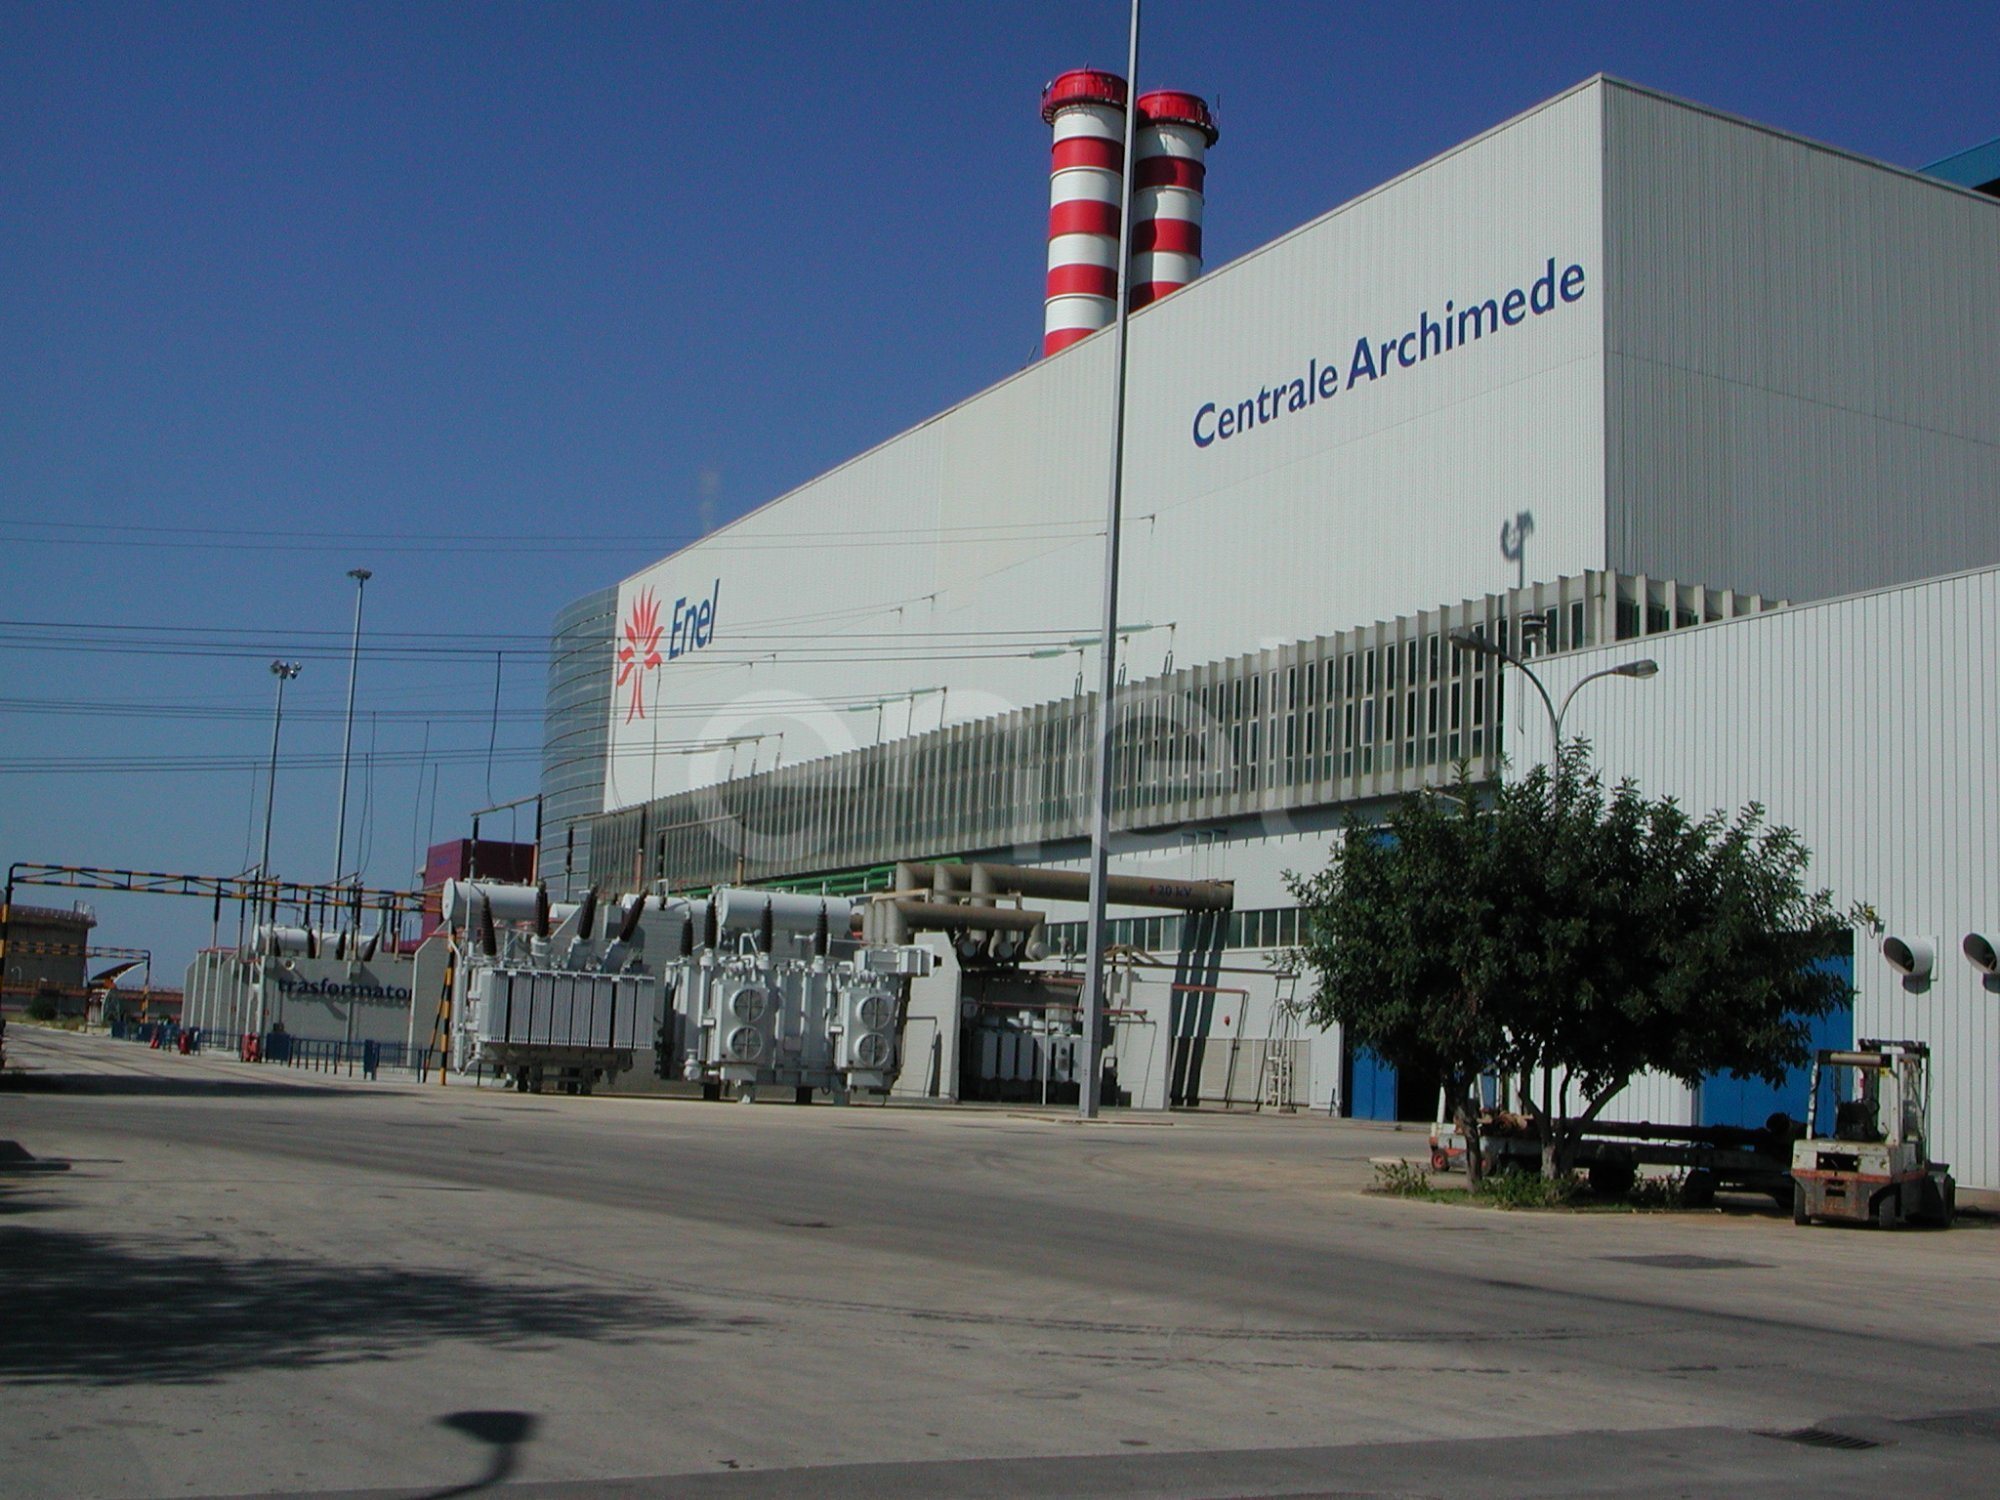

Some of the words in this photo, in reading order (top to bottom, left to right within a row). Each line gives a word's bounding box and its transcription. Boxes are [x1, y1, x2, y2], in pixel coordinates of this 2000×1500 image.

[1192, 358, 1338, 448] Centrale
[1346, 257, 1585, 390] Archimede
[668, 578, 720, 660] Enel
